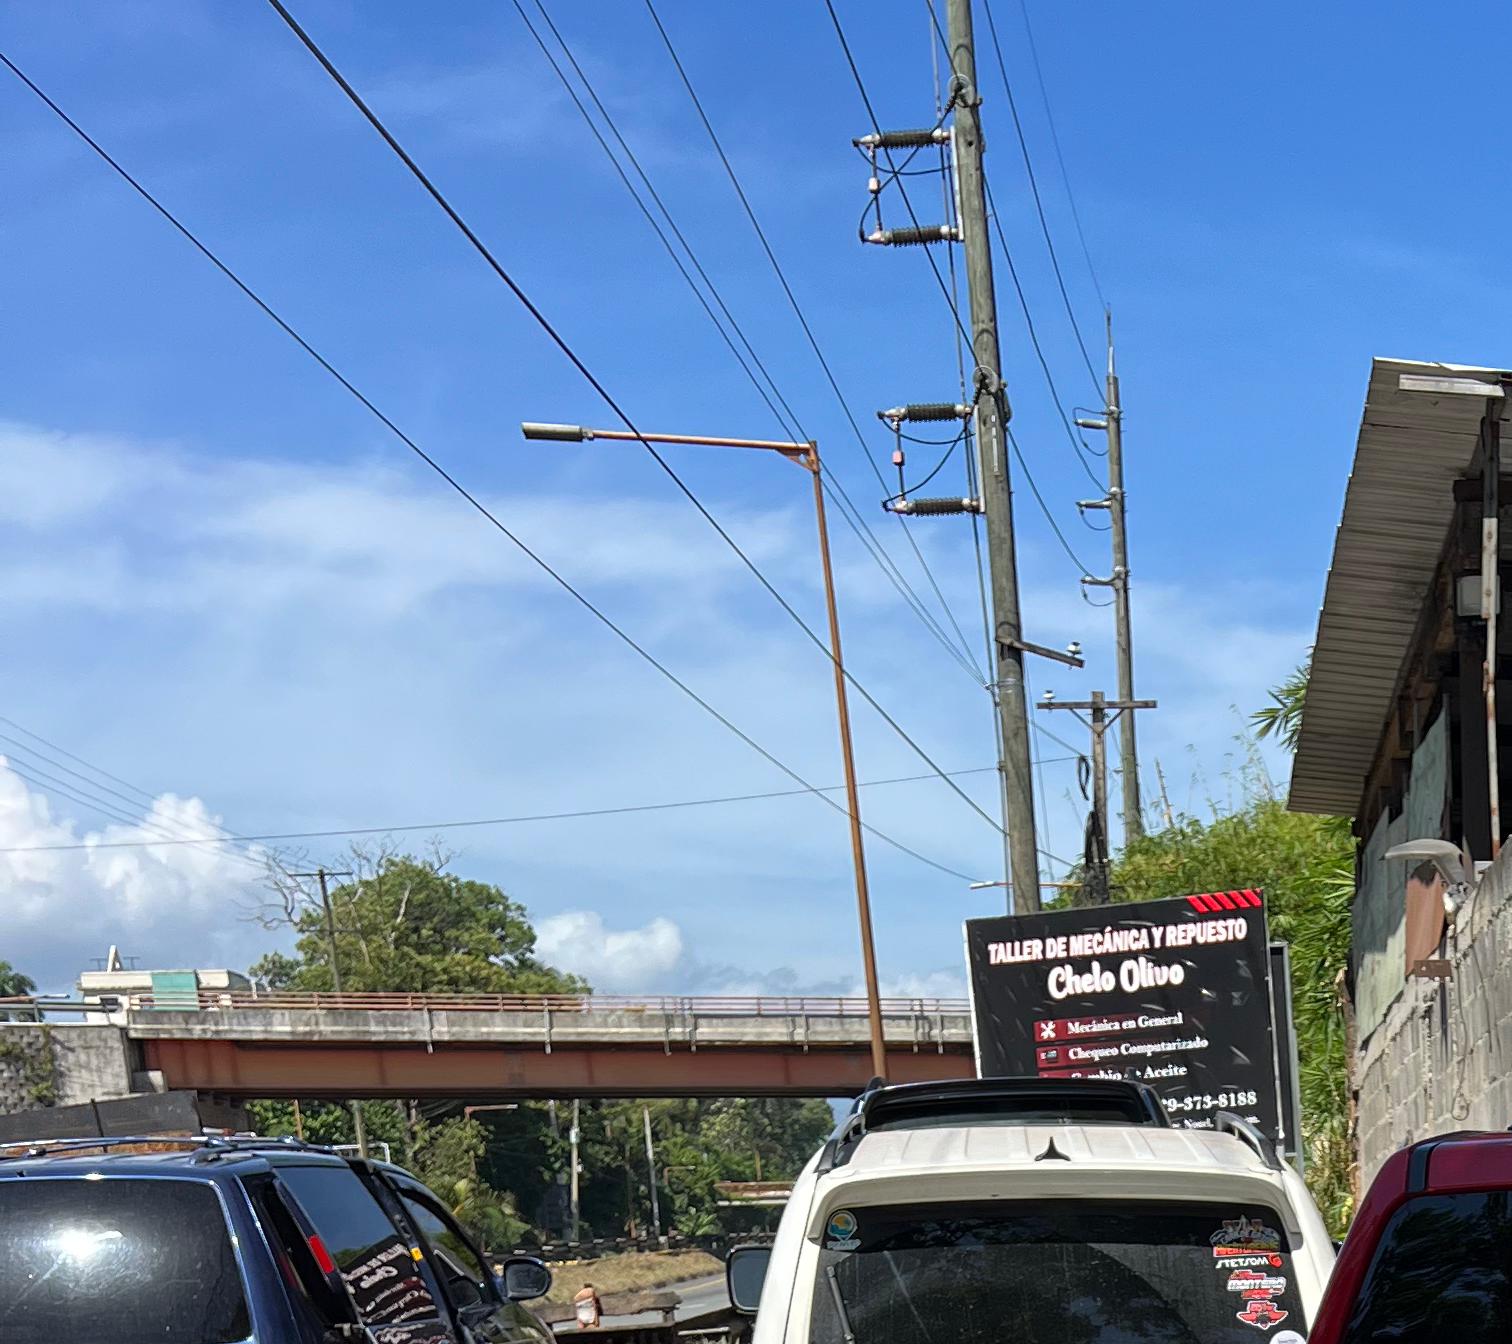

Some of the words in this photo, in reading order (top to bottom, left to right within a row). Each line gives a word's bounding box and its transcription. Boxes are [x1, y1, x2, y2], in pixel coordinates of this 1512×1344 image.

[988, 938, 1043, 965] TALLER
[1045, 936, 1068, 960] DE
[1069, 926, 1150, 957] MECÁNICA
[1151, 926, 1164, 948] Y
[1165, 917, 1248, 947] REPUESTO
[1047, 960, 1116, 999] Chelo
[1120, 956, 1185, 993] Olivo
[1067, 1018, 1121, 1035] Mecánica
[1122, 1020, 1137, 1030] en
[1137, 1010, 1184, 1028] General
[1068, 1045, 1119, 1061] Chequeo
[1120, 1034, 1209, 1056] Computarizado
[1143, 1064, 1188, 1079] Aceite
